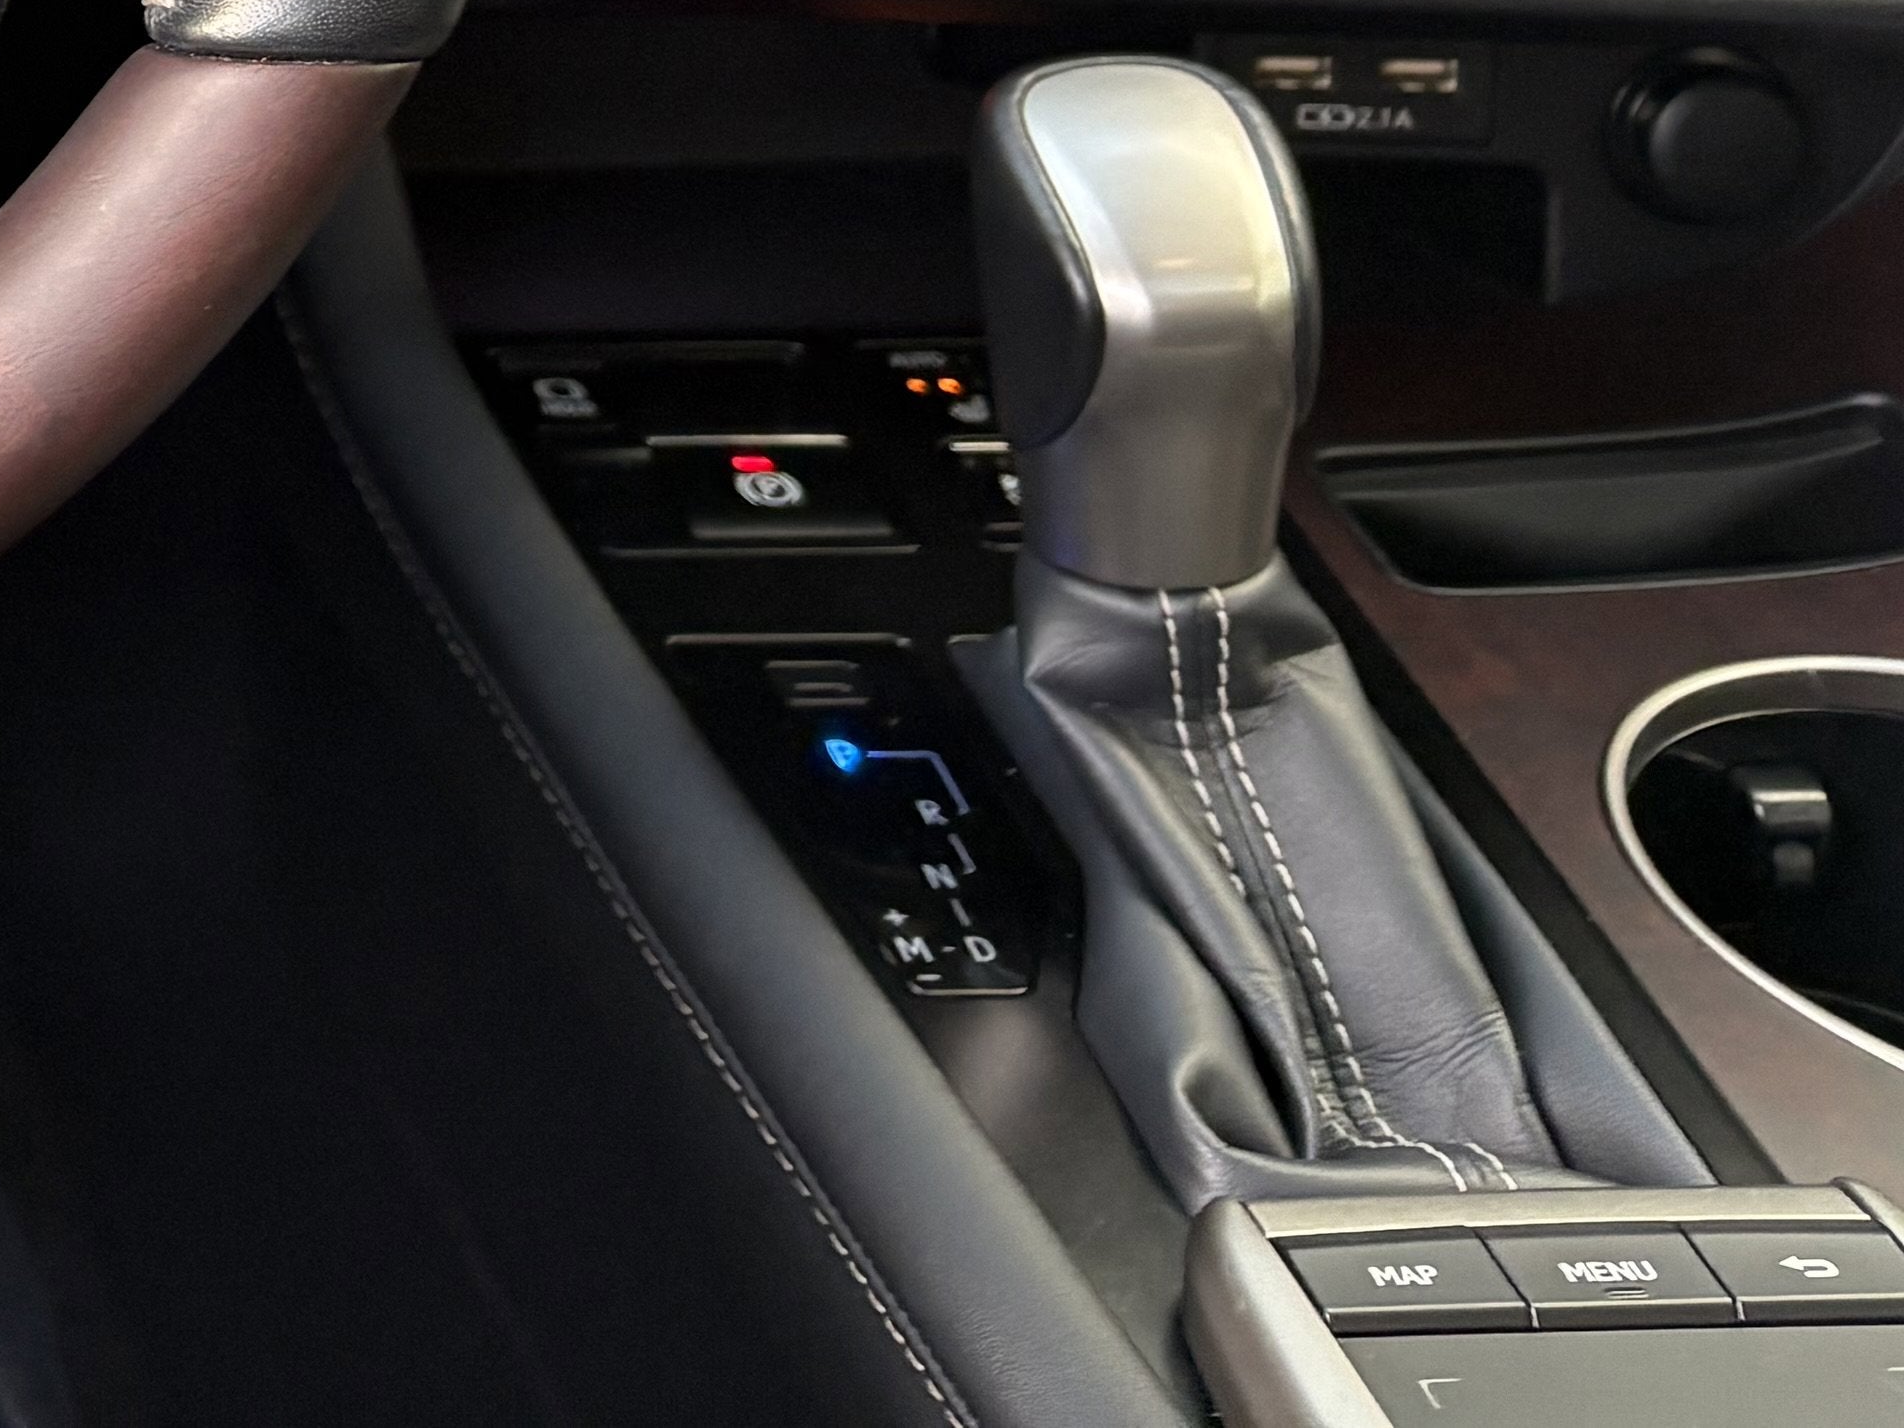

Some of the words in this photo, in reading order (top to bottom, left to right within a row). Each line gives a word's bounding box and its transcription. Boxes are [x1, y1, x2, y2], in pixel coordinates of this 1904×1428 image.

[921, 863, 959, 890] N
[893, 937, 935, 964] M
[963, 936, 998, 963] D
[1367, 1263, 1439, 1288] MAP
[1557, 1258, 1659, 1285] MENU
